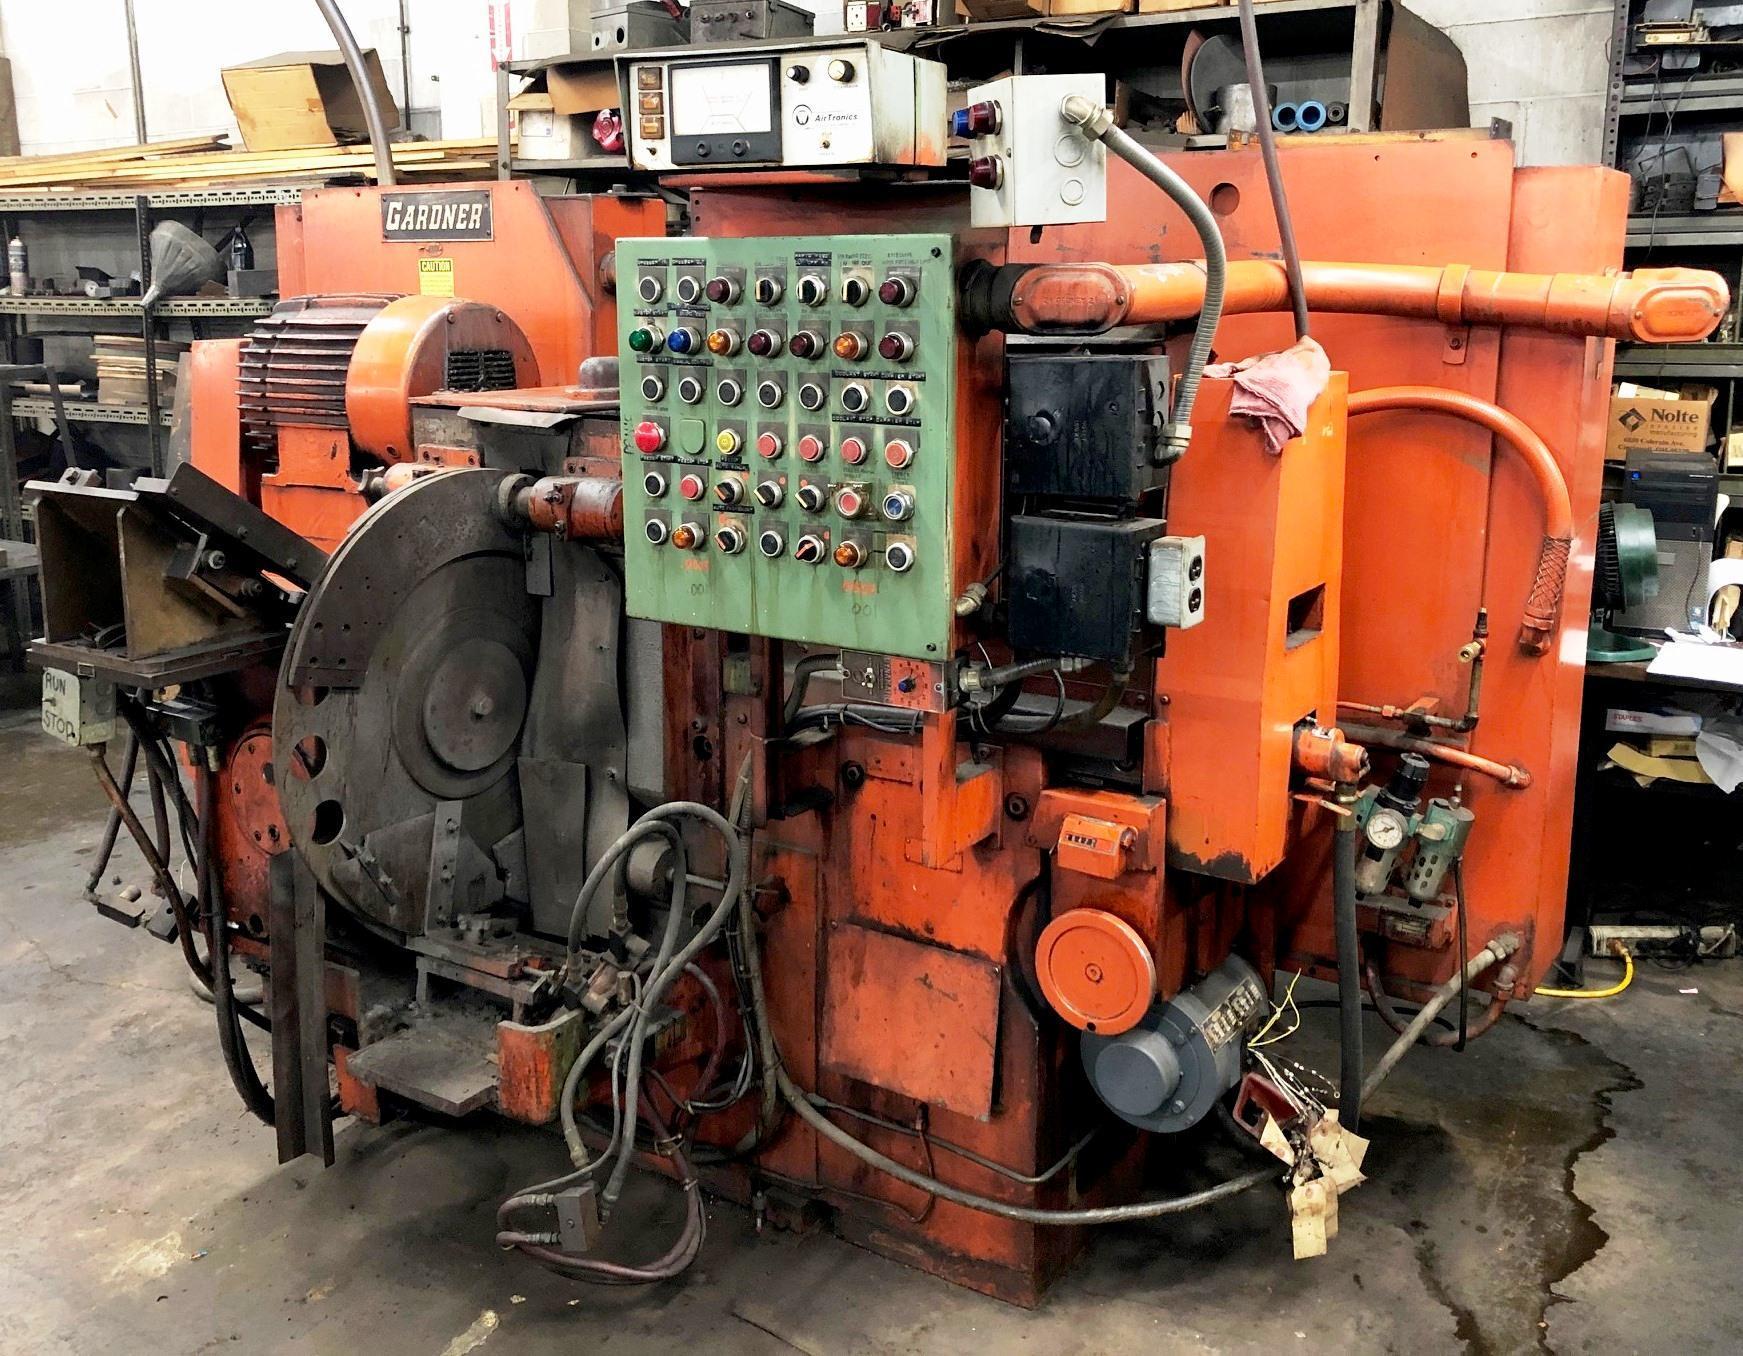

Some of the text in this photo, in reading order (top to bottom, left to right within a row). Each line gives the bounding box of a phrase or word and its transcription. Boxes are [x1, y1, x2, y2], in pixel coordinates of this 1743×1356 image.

[814, 113, 858, 122] AirTronics
[385, 201, 483, 231] GARDNER
[422, 261, 451, 272] CAUTION
[1650, 408, 1699, 423] Nolte
[45, 672, 66, 696] RUN
[1614, 712, 1643, 722] STAPLES
[43, 710, 76, 740] STOP
